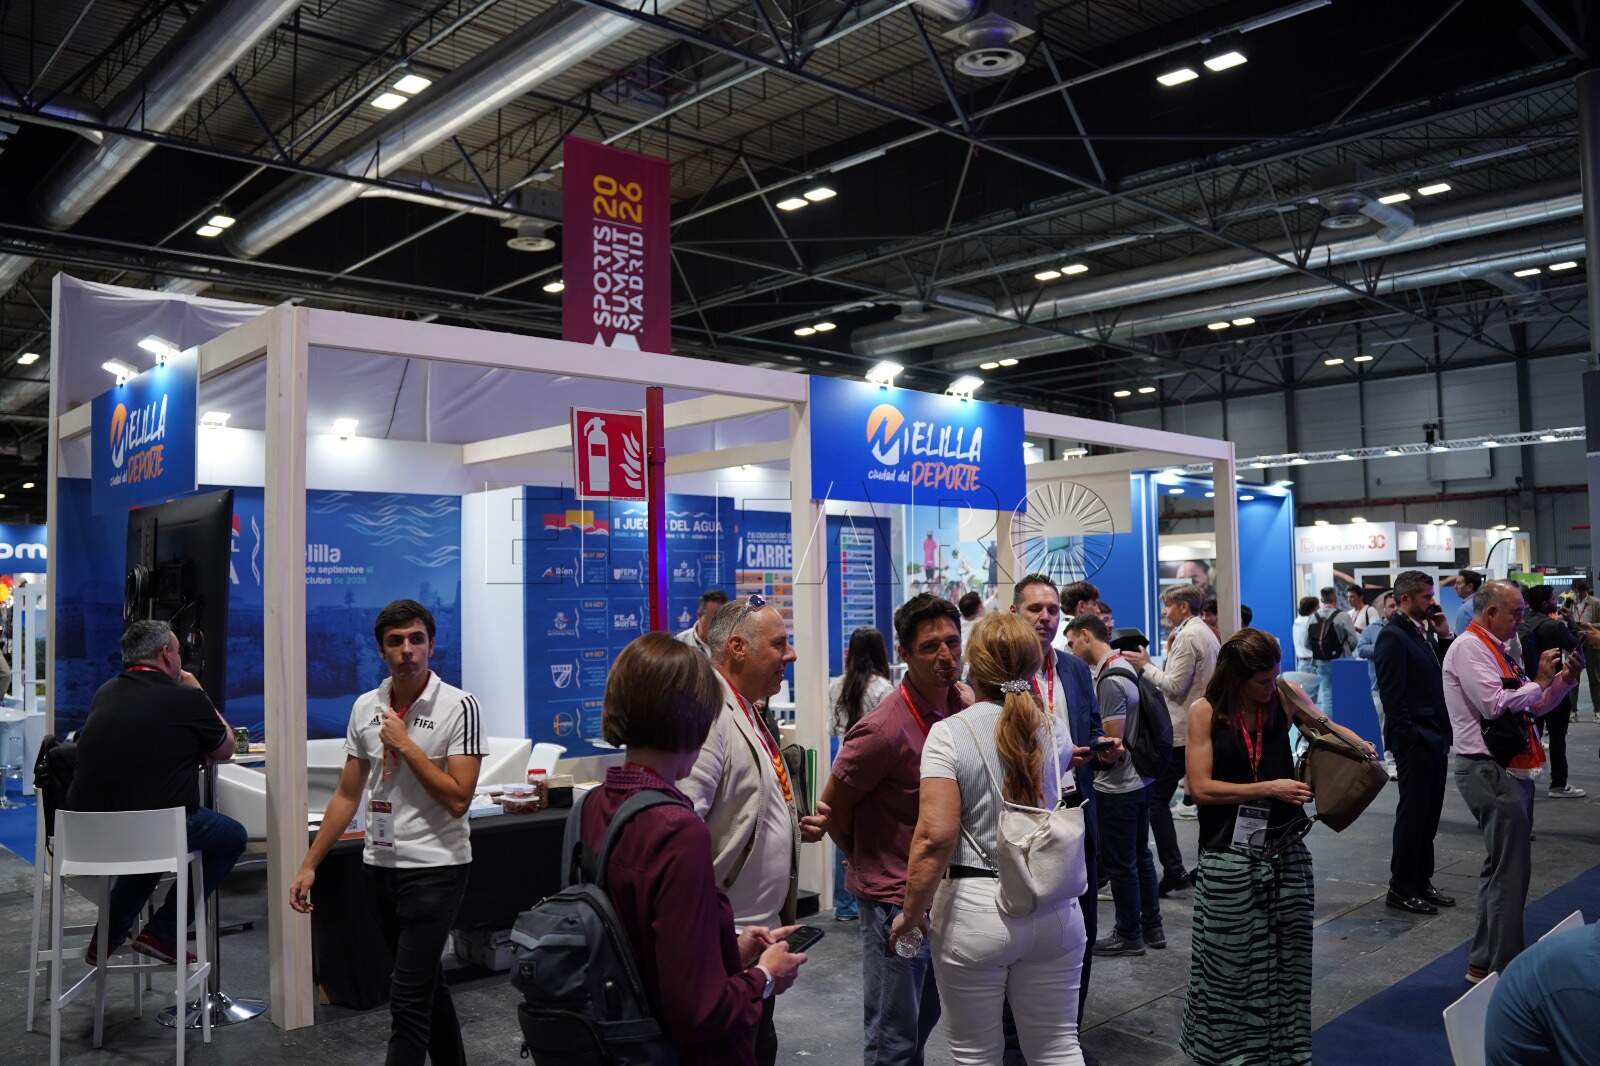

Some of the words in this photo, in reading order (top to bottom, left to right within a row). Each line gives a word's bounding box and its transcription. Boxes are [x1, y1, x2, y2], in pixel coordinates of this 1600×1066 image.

[593, 174, 618, 219] 20
[618, 181, 643, 225] 26
[593, 225, 612, 328] SPORTS
[611, 227, 629, 331] SUMMIT
[628, 231, 644, 334] MADRID
[867, 468, 896, 481] ciudad
[897, 469, 910, 483] del
[911, 460, 982, 492] DEPORTE
[669, 519, 691, 532] DEL
[692, 520, 724, 533] AGUA
[305, 576, 332, 585] ctubre
[318, 566, 364, 576] septiembre
[413, 717, 434, 731] FIFA
